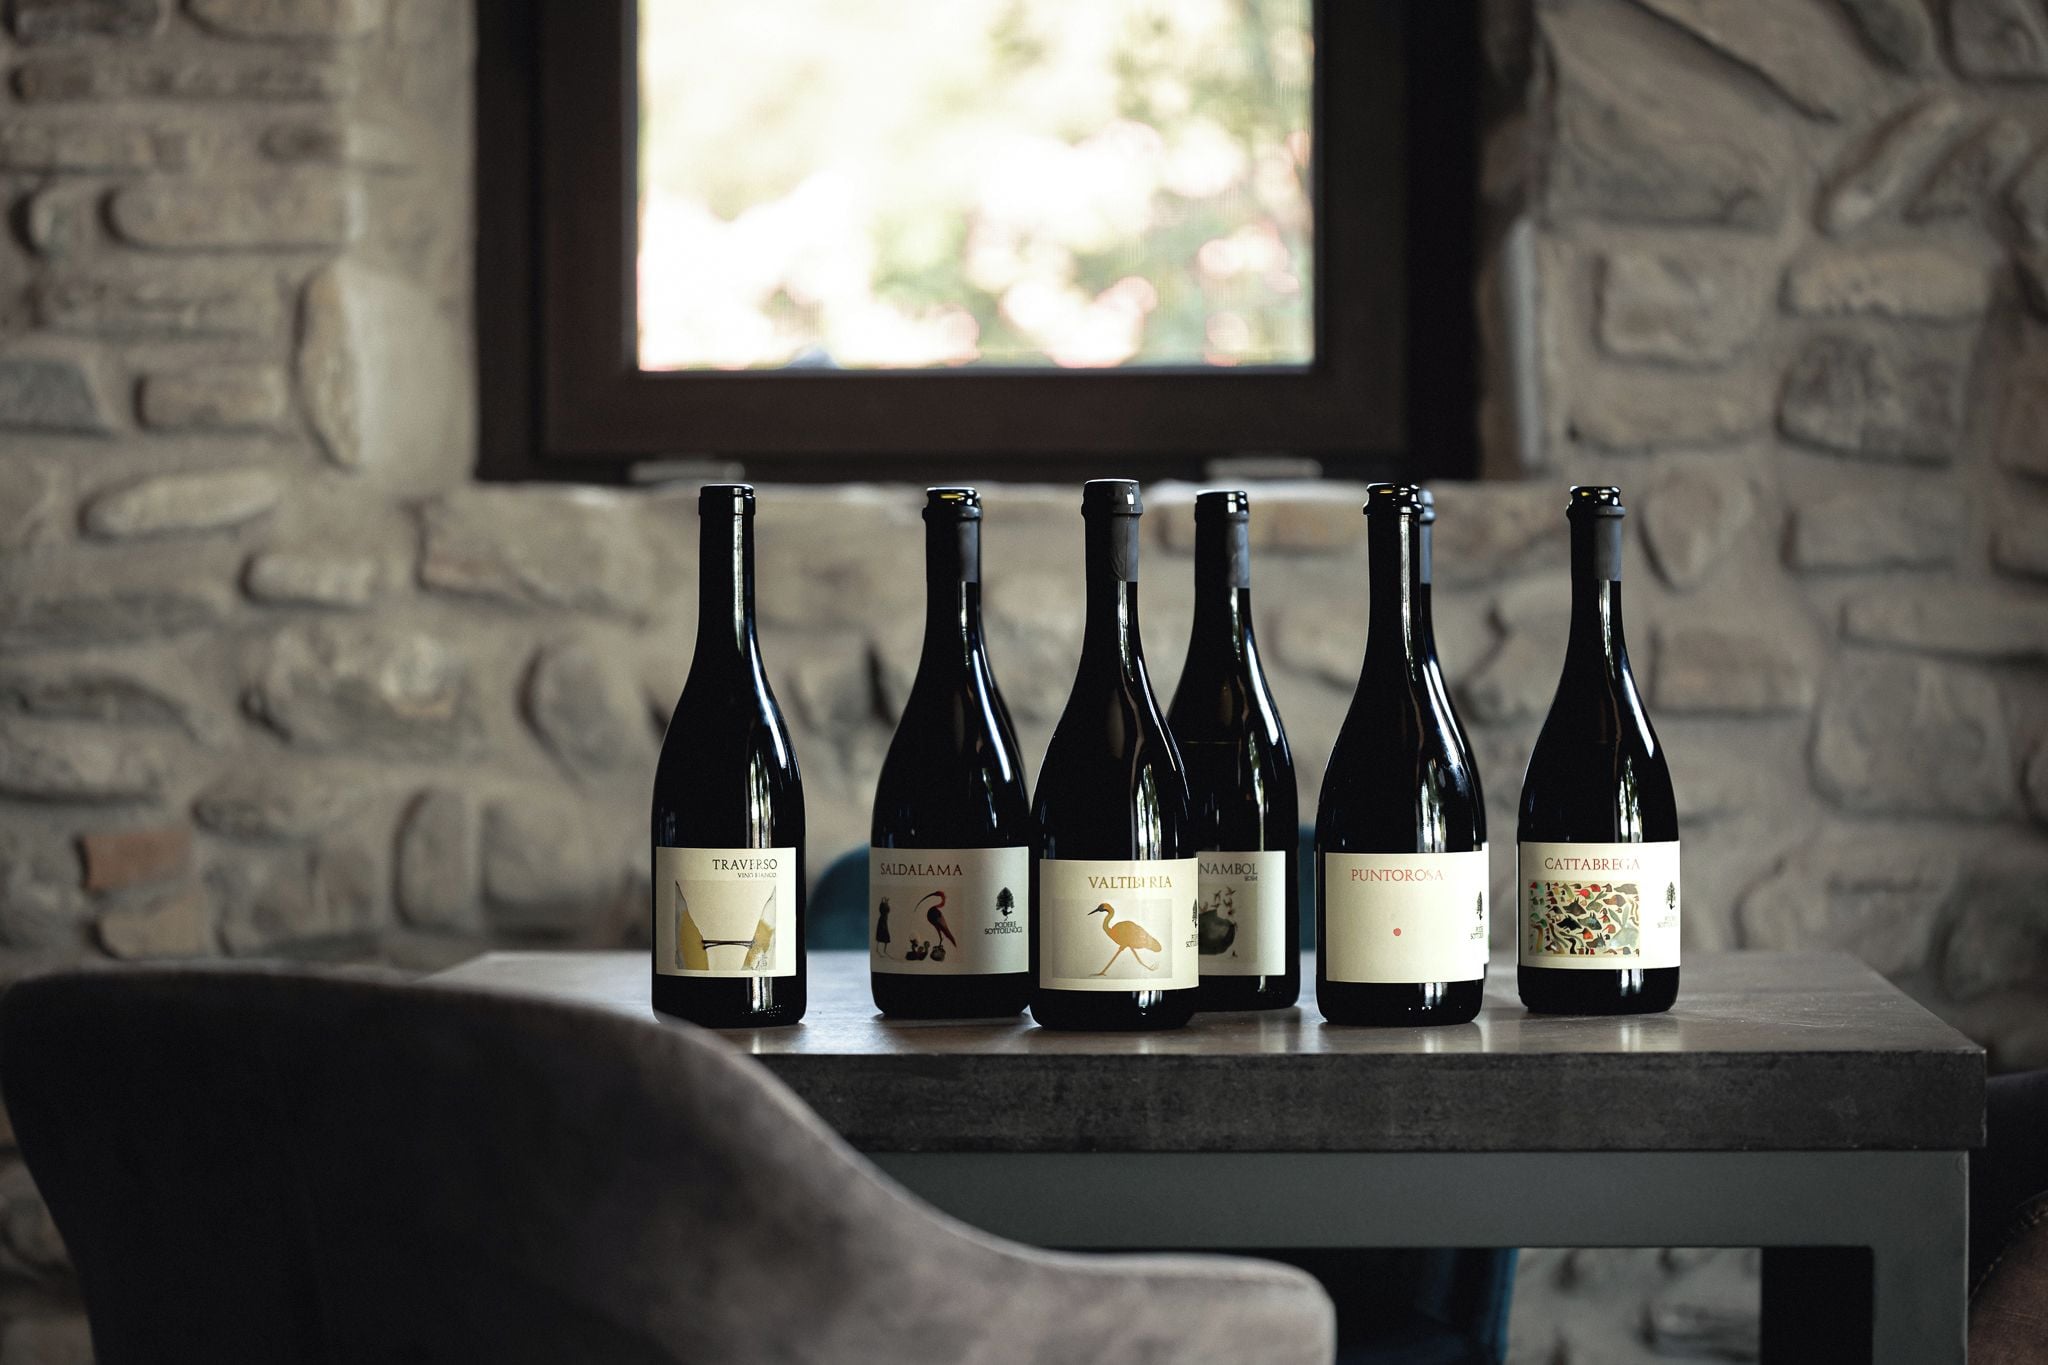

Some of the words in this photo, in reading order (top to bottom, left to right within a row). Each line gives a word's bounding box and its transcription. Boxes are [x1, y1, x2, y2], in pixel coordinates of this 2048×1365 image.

[712, 858, 778, 870] TRAVERSO
[880, 862, 963, 876] SALDALAMA
[1351, 869, 1444, 881] PUNTOROSA
